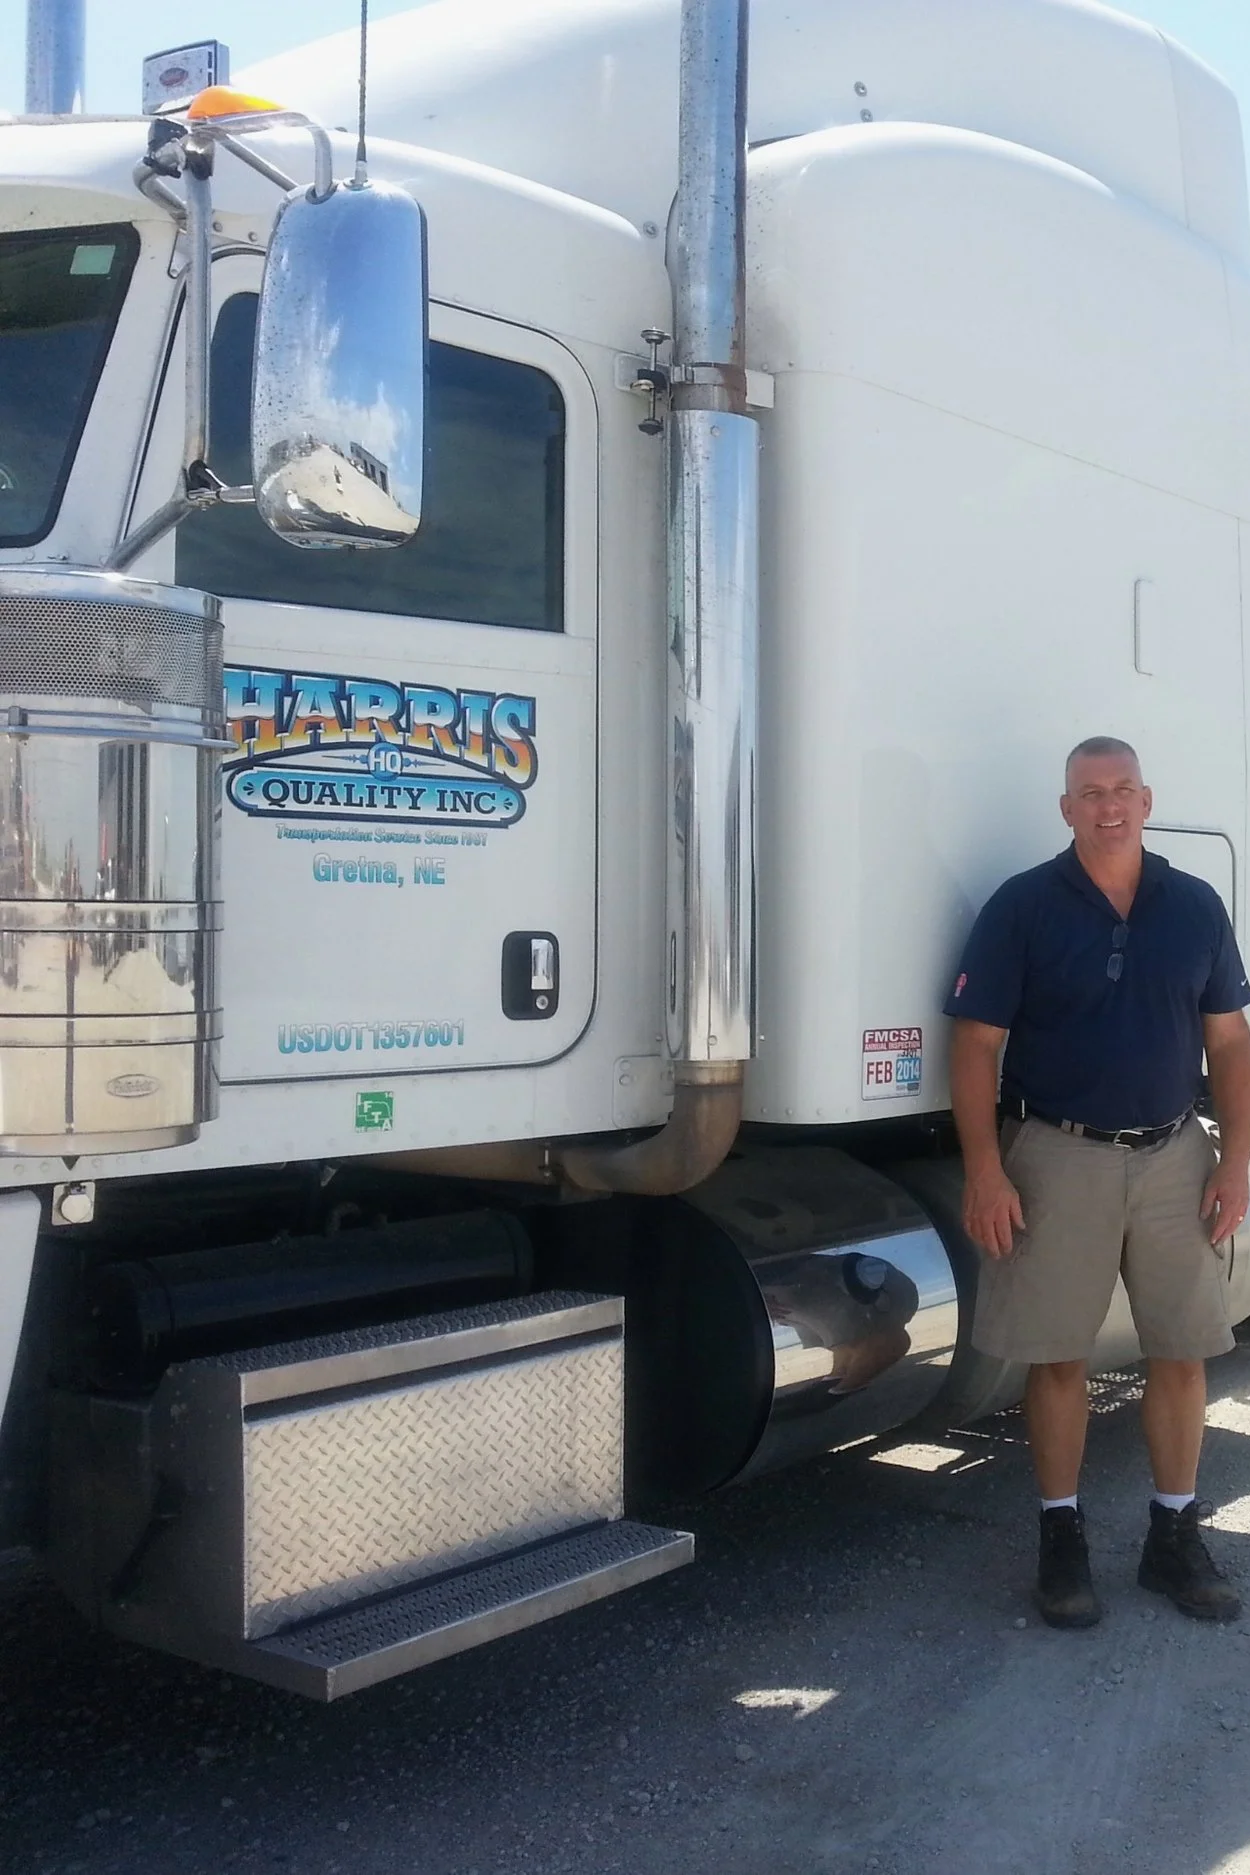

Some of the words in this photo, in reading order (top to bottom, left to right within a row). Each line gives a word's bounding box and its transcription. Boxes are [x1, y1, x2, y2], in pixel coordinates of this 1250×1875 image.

[223, 663, 538, 789] HARRIS
[371, 749, 401, 774] HQ
[262, 778, 426, 808] QUALITY
[437, 790, 496, 814] INC
[374, 826, 421, 844] Service
[313, 852, 404, 888] Gretna,
[414, 857, 446, 885] NE
[278, 1018, 465, 1054] USDOT1357601
[865, 1030, 920, 1043] FMCSA
[866, 1061, 892, 1085] FEB
[897, 1060, 920, 1081] 2014
